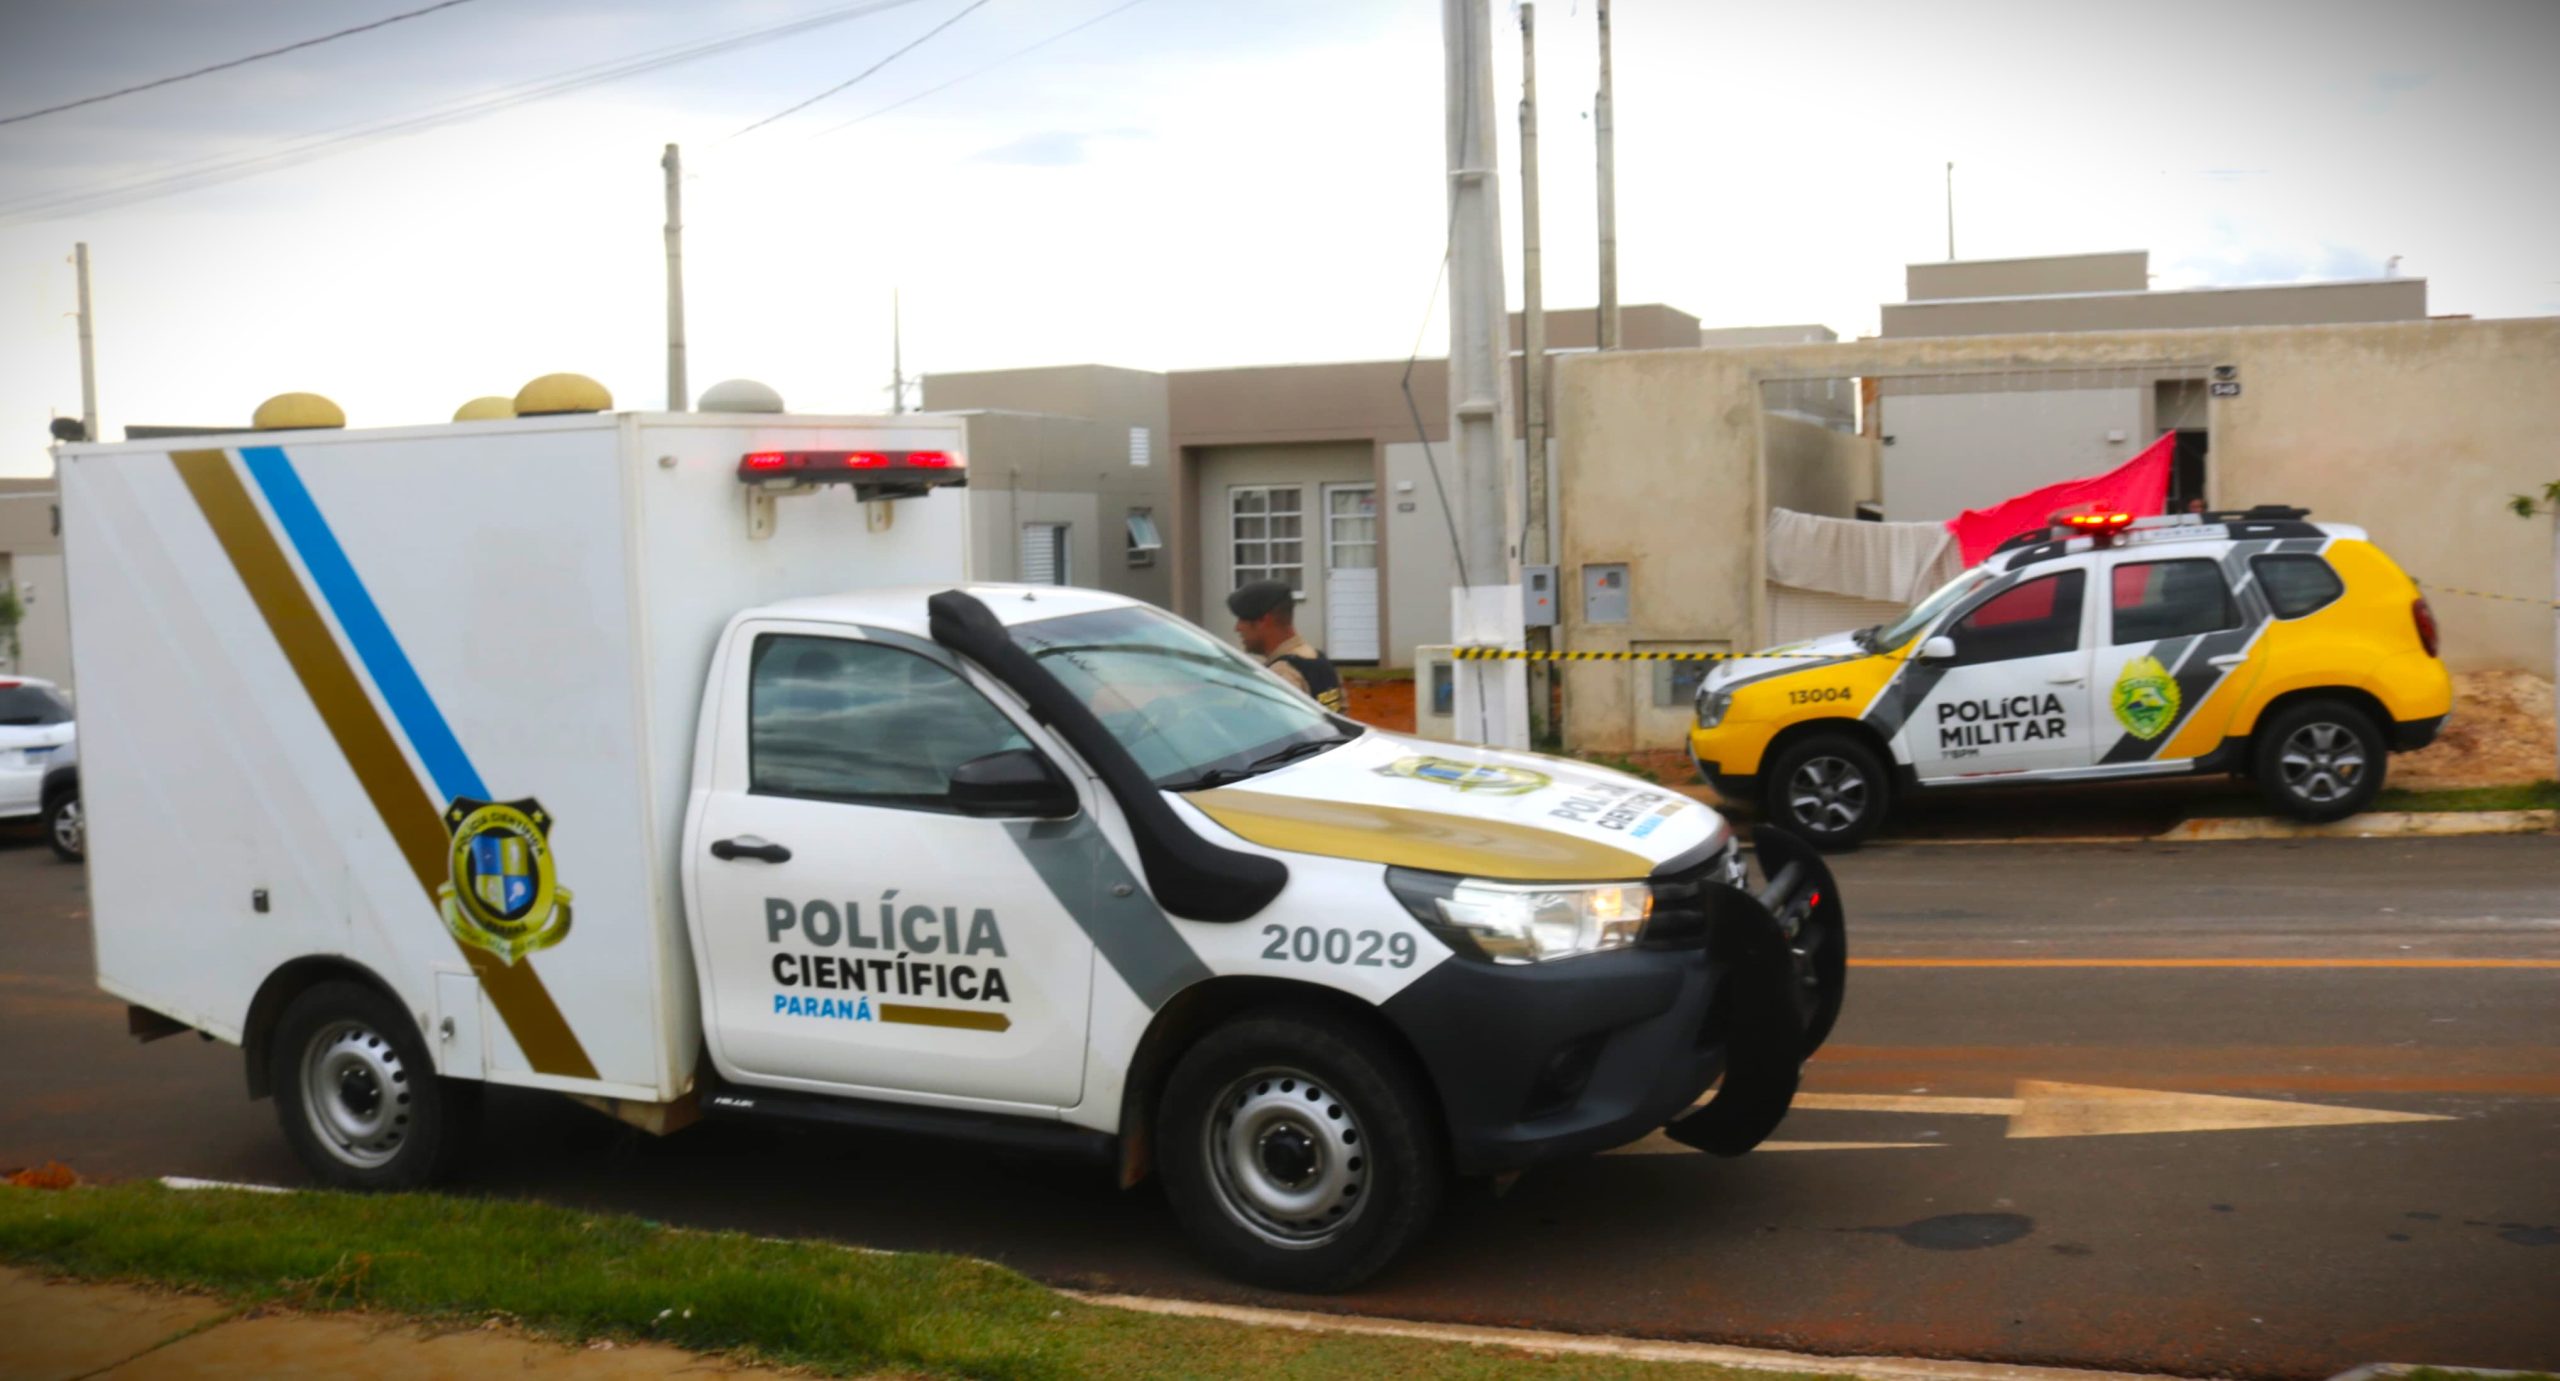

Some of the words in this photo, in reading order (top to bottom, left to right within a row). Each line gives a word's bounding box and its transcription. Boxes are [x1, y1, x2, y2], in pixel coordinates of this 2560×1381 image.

[1788, 686, 1852, 704] 13004
[1940, 718, 2067, 748] MILITAR
[764, 889, 1008, 957] POLÍCIA
[1261, 924, 1417, 969] 20029
[772, 952, 1011, 1003] CIENTÍFICA
[773, 994, 872, 1022] PARANÁ
